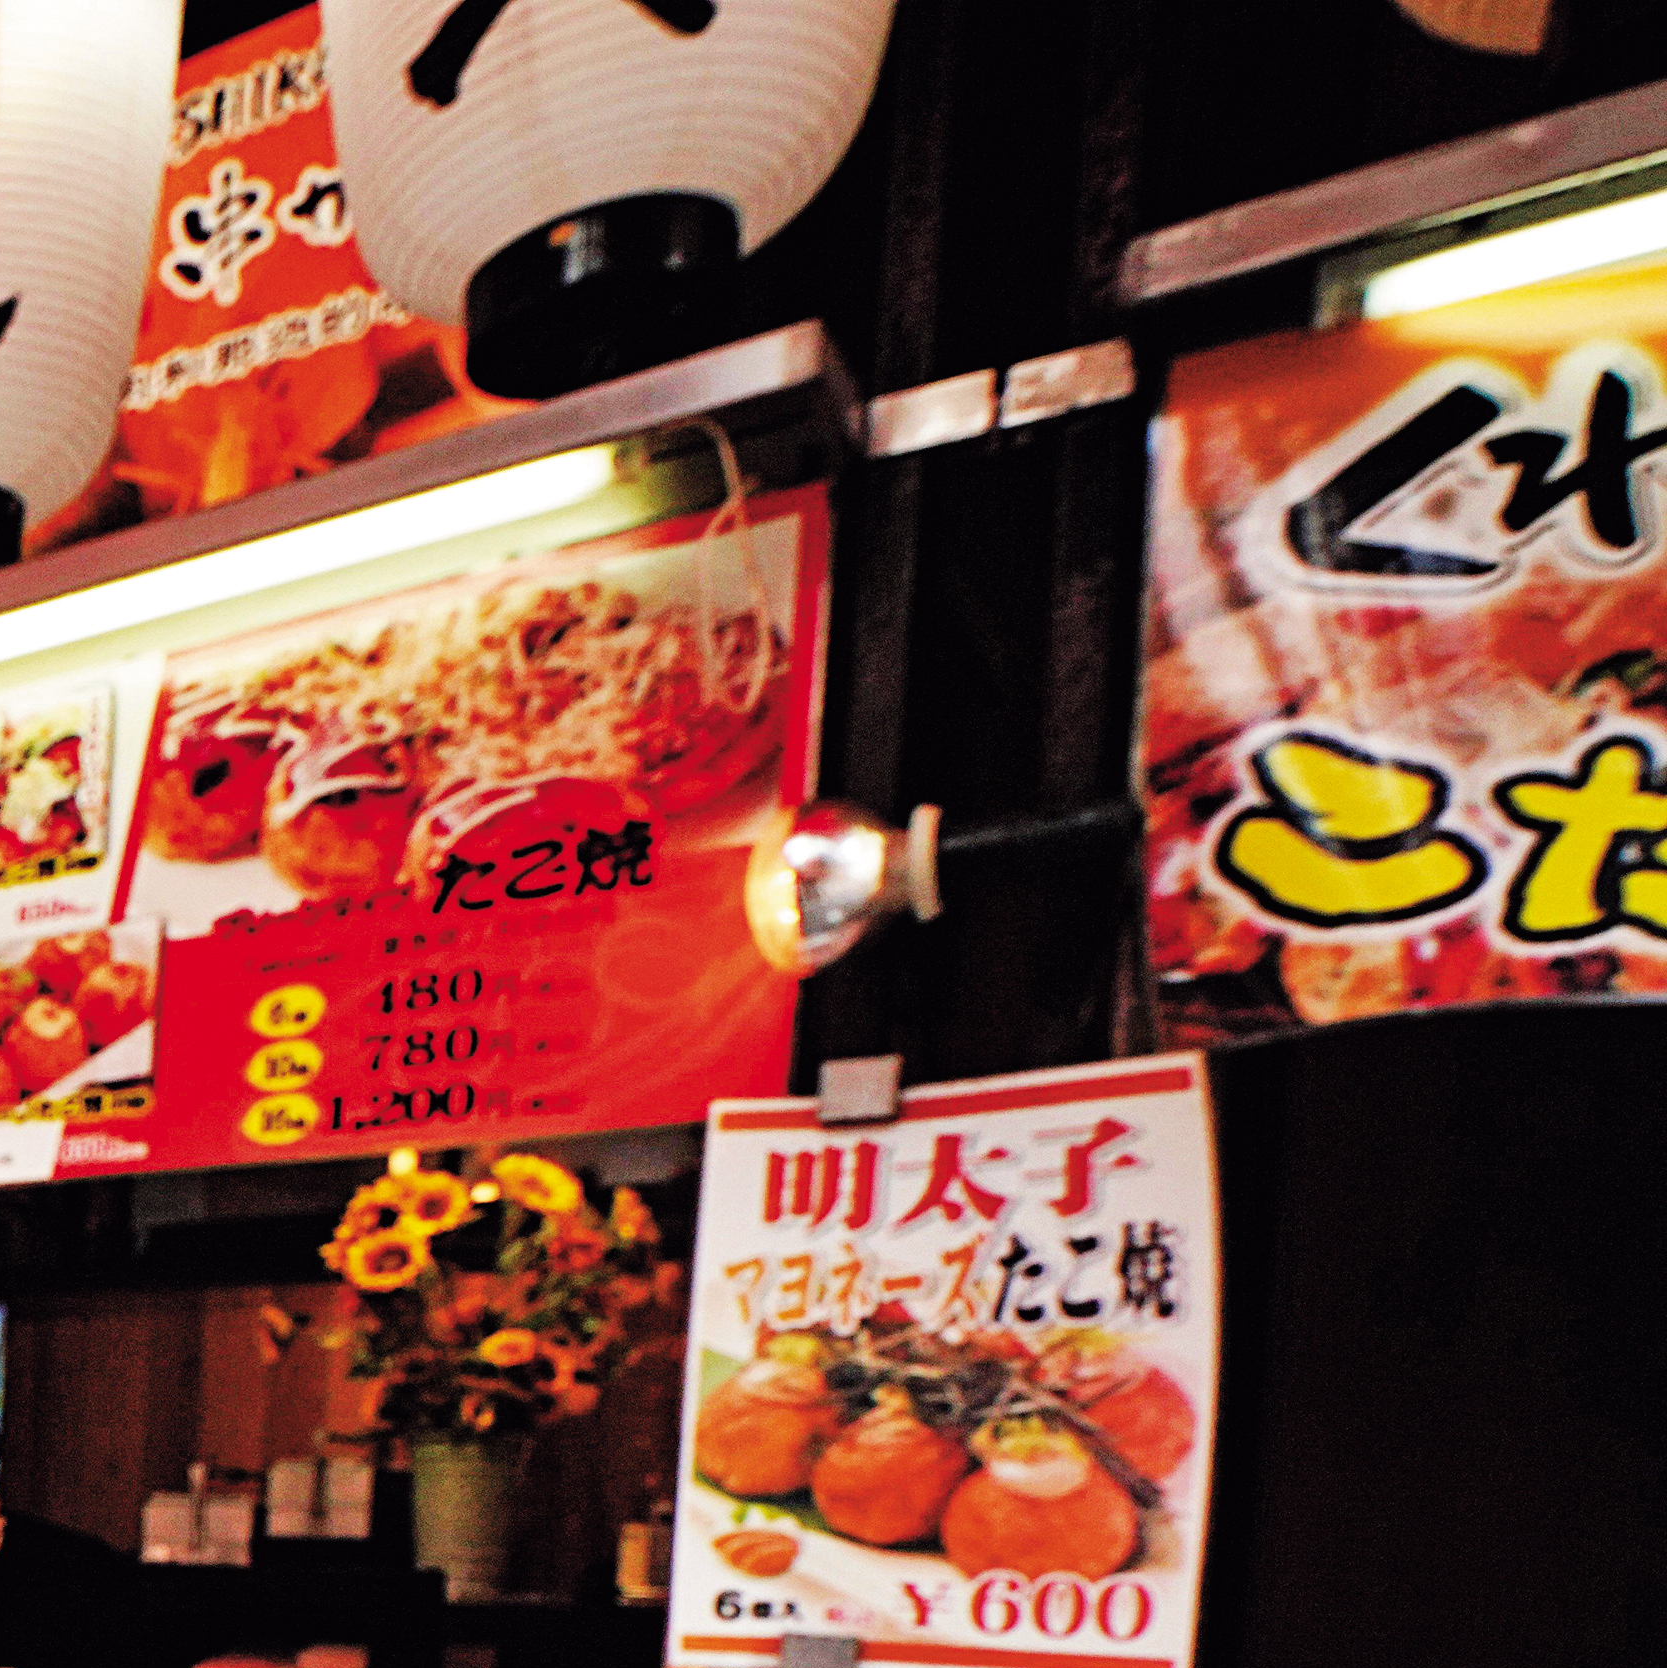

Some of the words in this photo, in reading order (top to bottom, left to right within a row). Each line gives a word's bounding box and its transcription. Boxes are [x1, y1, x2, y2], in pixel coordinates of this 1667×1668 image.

[433, 818, 654, 914] たこ焼
[365, 1024, 479, 1071] 780
[331, 1081, 476, 1132] 1,200
[761, 1117, 1147, 1231] 明太子
